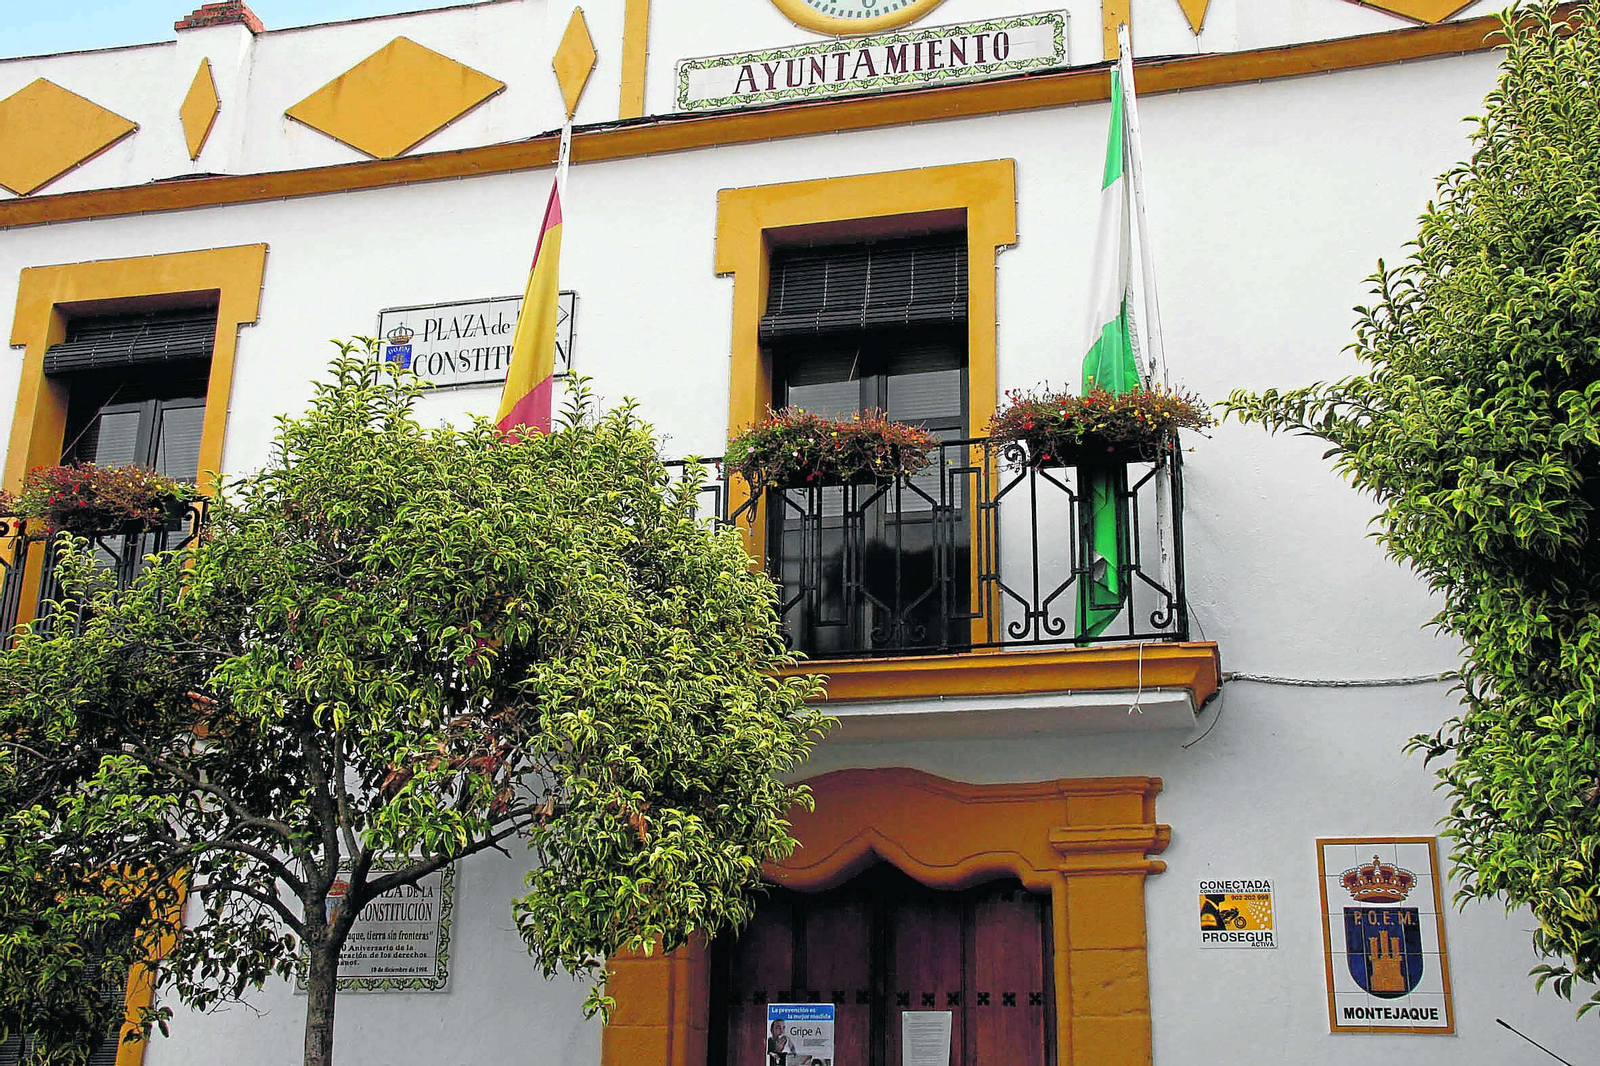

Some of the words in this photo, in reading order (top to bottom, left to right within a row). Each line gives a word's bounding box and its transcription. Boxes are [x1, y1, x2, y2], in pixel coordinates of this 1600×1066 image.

[732, 32, 1010, 94] AYUNTAMIENTO
[423, 313, 489, 342] PLAZA
[491, 311, 511, 335] de
[412, 340, 569, 377] CONSTITN
[1200, 880, 1271, 889] CONECTADA
[407, 886, 419, 898] DE
[422, 885, 434, 898] LA
[366, 930, 386, 941] tierra
[387, 930, 397, 941] sin
[1202, 932, 1273, 943] PROSEGUR
[348, 944, 394, 952] Aniversario
[369, 951, 379, 959] de
[380, 951, 391, 959] los
[393, 951, 427, 959] derechos
[779, 1006, 809, 1015] prevención
[1344, 1007, 1439, 1020] MONTEJAQUE
[794, 1013, 810, 1021] mejor
[790, 1027, 813, 1038] Gripe
[815, 1027, 822, 1036] A
